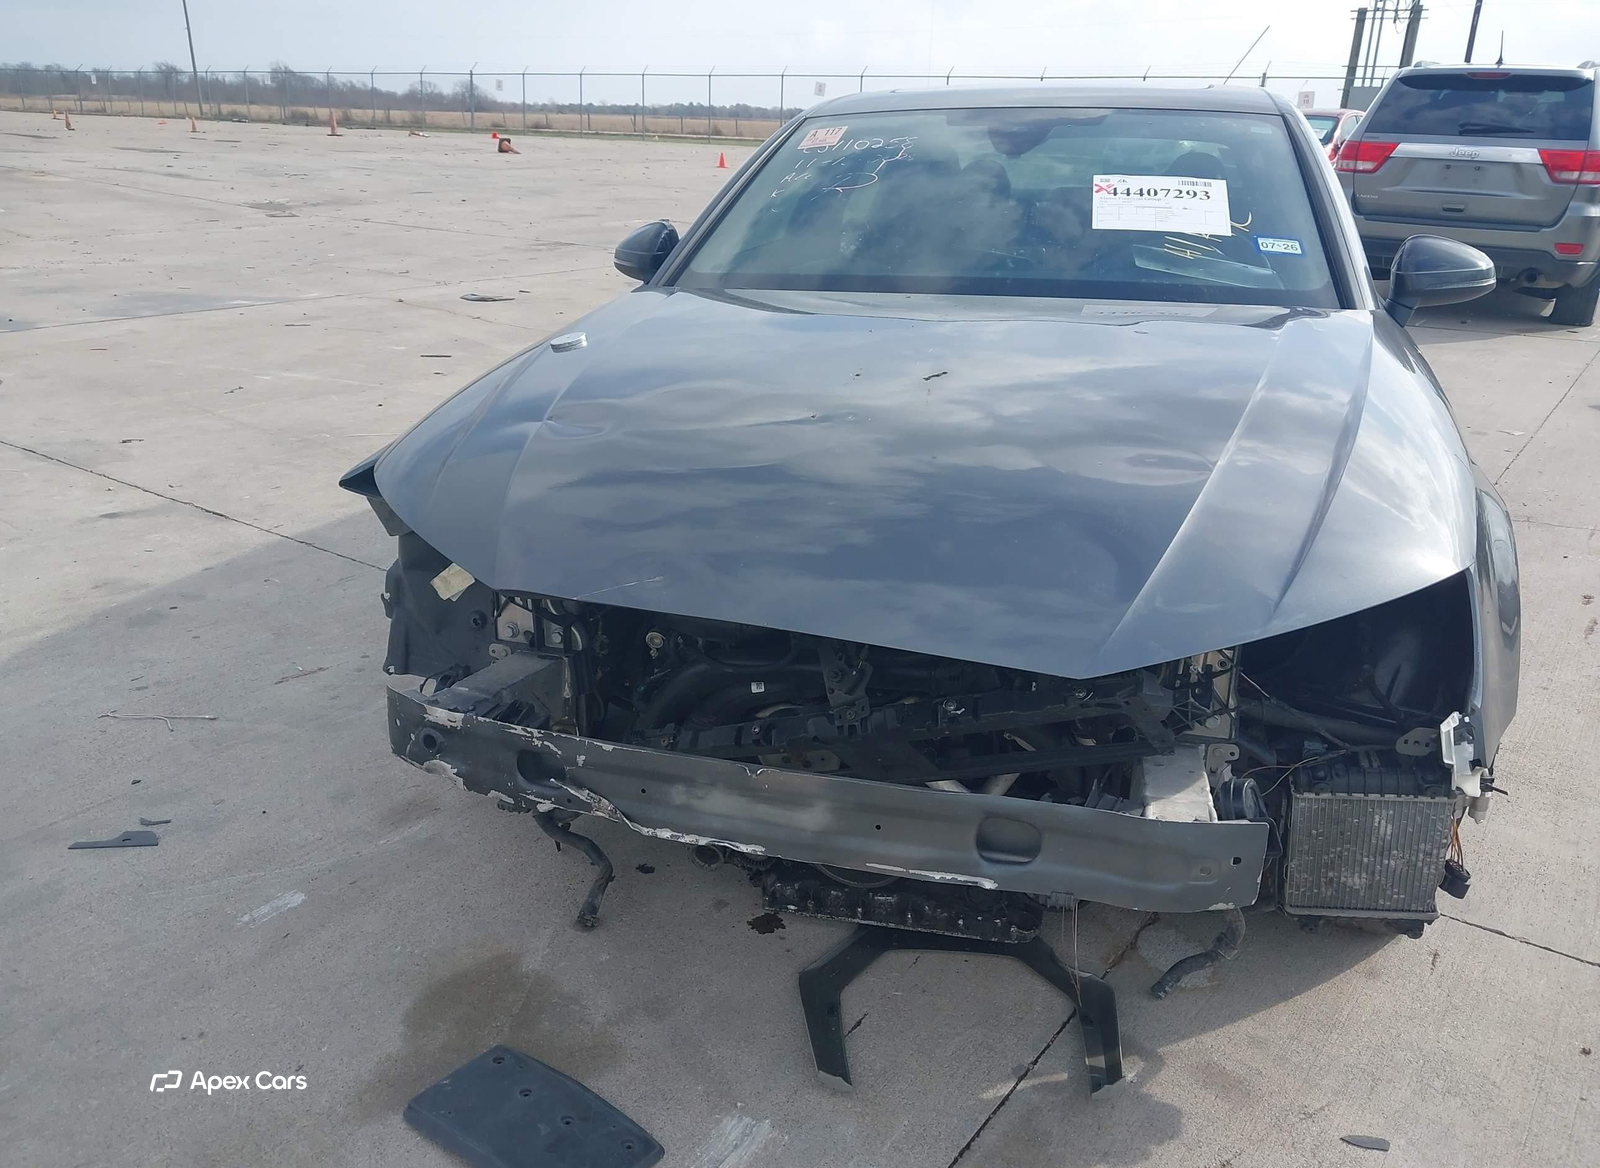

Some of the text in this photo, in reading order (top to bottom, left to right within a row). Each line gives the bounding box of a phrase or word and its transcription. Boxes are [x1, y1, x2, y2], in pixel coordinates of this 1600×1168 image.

[825, 128, 842, 136] 117
[1450, 147, 1480, 159] Jeep
[1107, 187, 1211, 200] 44407293
[1283, 243, 1298, 251] 26
